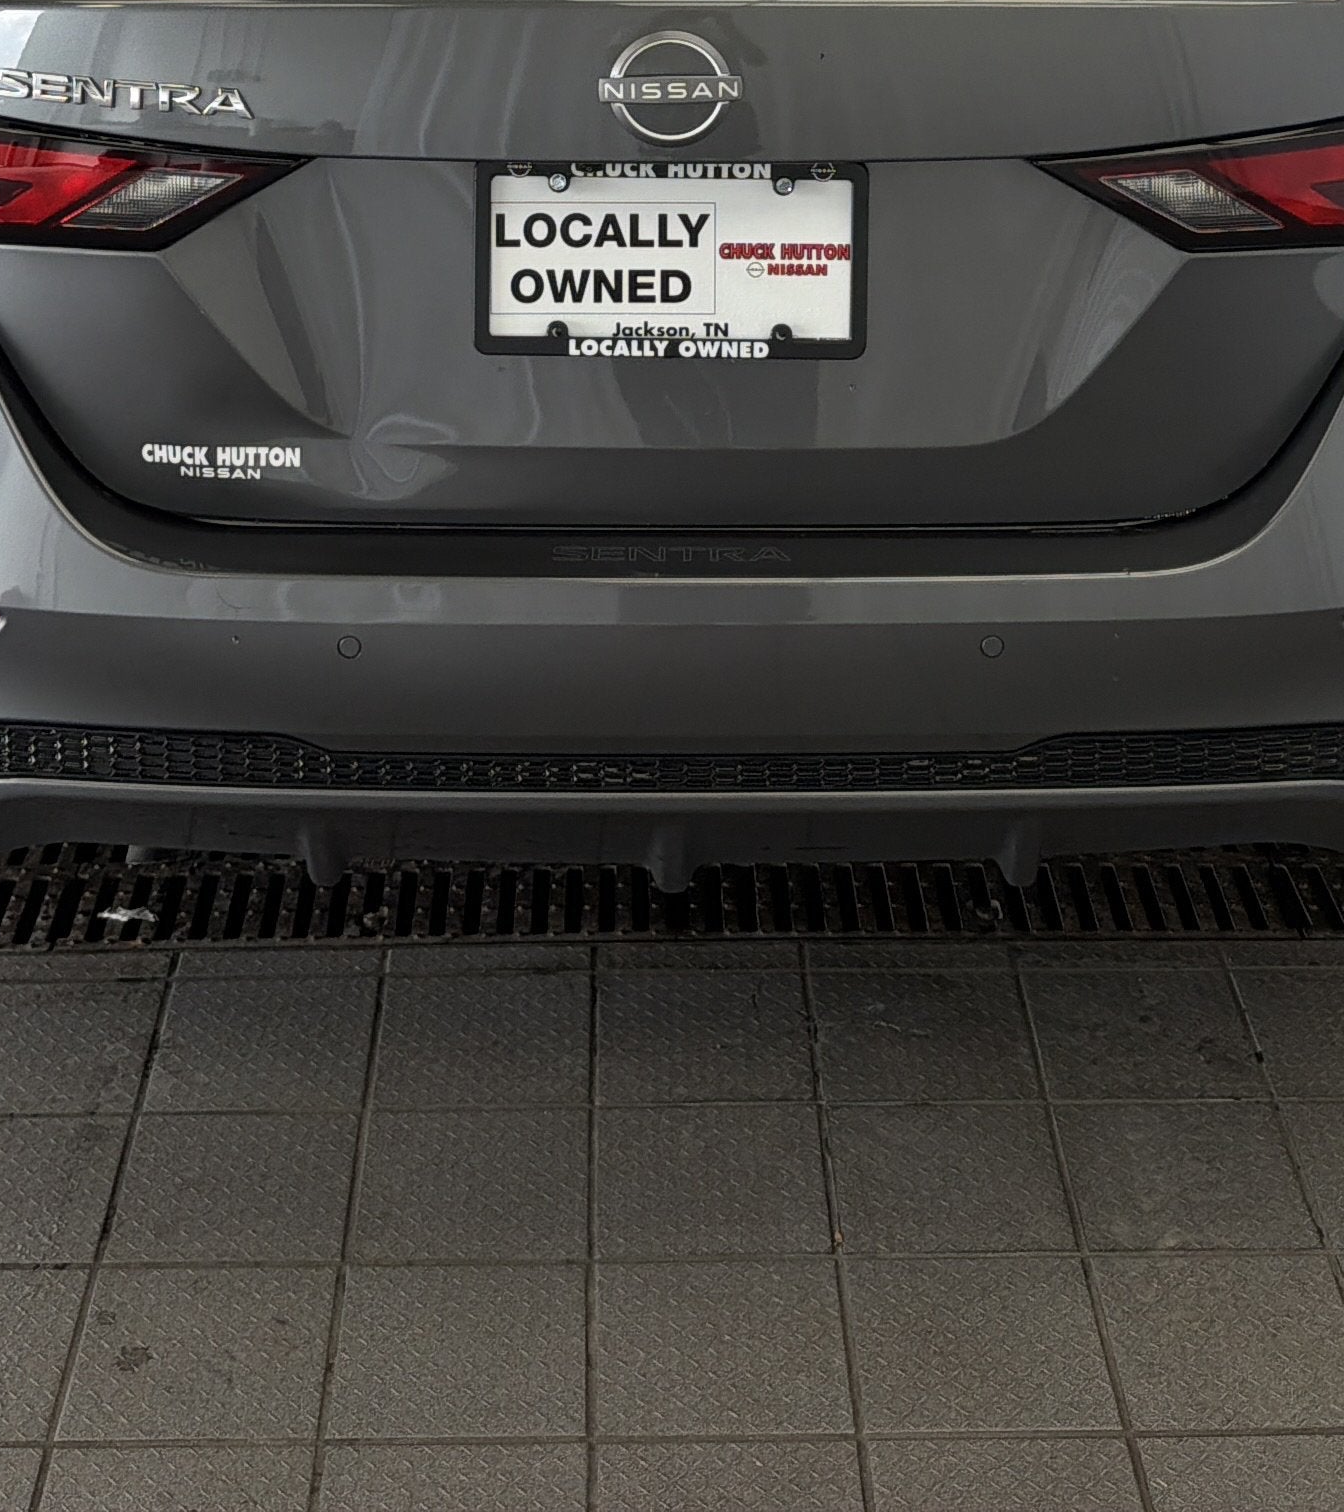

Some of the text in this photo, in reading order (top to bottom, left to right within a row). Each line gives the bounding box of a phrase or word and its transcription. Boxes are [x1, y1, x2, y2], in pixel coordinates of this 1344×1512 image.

[604, 81, 739, 99] NISSAN
[570, 163, 773, 179] CUCK HUTTON
[495, 213, 711, 248] LOCALLY
[719, 242, 851, 260] CHUCK HUTTON
[767, 263, 828, 276] NISSAN
[510, 268, 693, 304] OWNED
[612, 322, 729, 339] Jackson, TN
[568, 339, 770, 359] LOCALLY OWNED
[141, 443, 301, 468] CHUCK HUTTON
[180, 465, 261, 480] NISSAN
[552, 546, 792, 562] SENTRA
